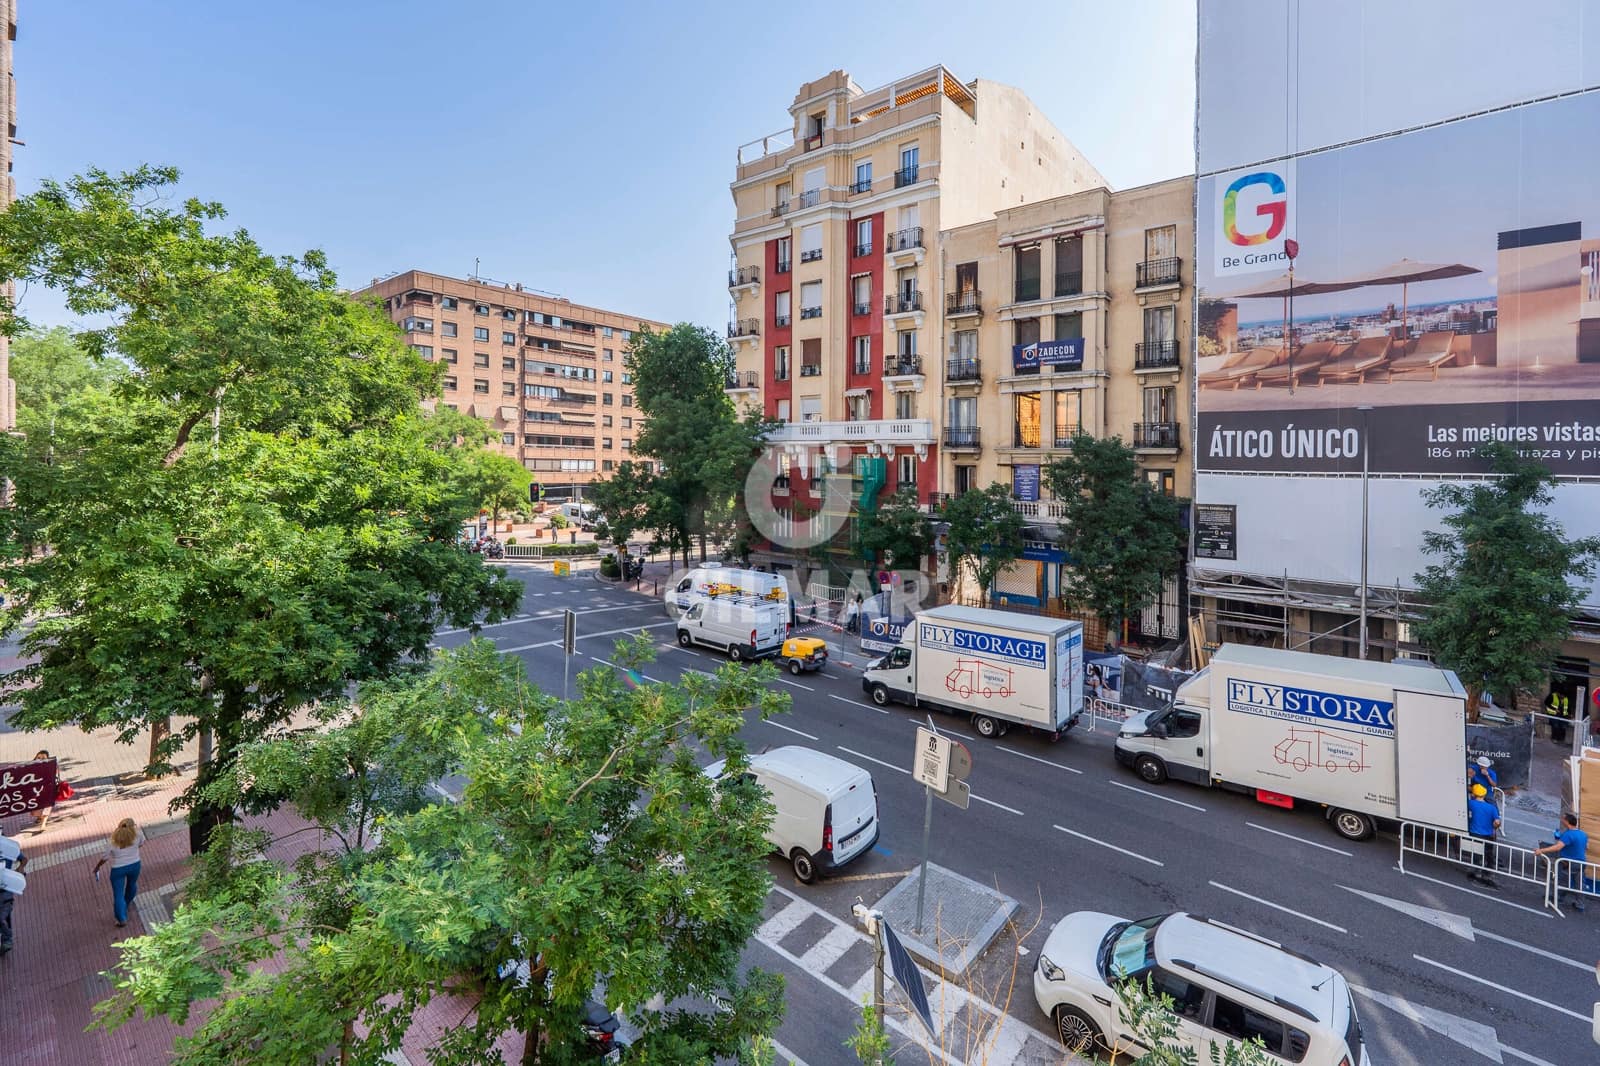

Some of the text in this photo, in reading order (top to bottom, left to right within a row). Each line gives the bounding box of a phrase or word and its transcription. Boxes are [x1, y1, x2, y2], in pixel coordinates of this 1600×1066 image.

[1223, 250, 1288, 268] Be Grand
[1038, 344, 1075, 357] ZADECON
[1209, 423, 1359, 458] ÁTICO ÚNICO
[1428, 424, 1458, 443] Las
[1462, 423, 1538, 446] mejores
[1427, 447, 1451, 458] 186
[1566, 449, 1576, 461] y
[1366, 727, 1395, 737] GUARD
[32, 785, 44, 797] Y
